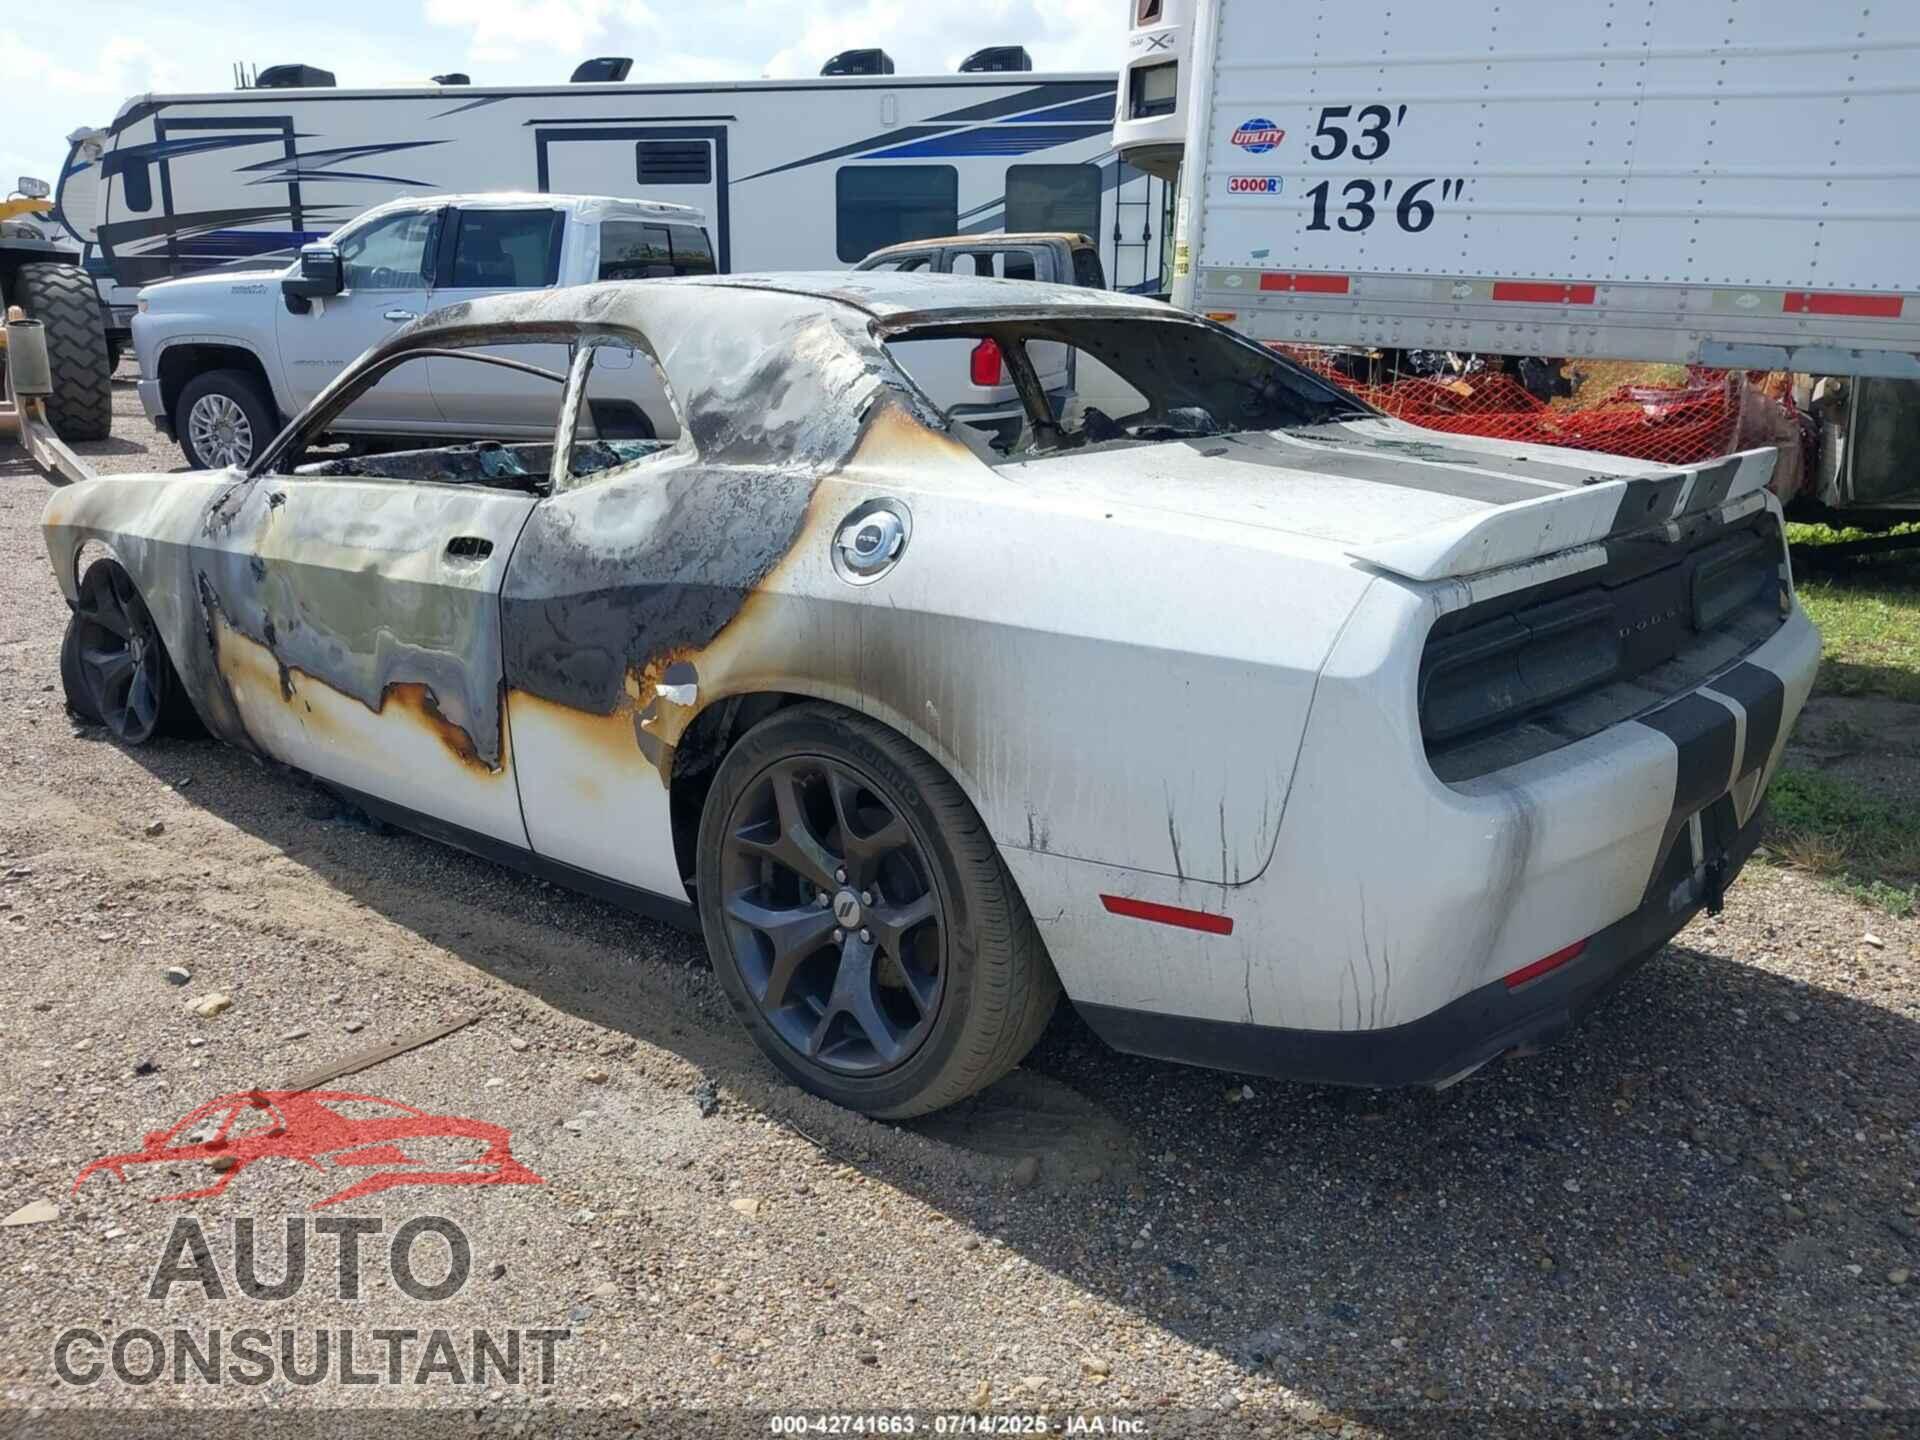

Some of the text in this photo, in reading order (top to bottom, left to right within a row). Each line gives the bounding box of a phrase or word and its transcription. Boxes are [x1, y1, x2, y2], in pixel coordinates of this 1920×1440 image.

[1233, 131, 1282, 144] UTILITY
[1310, 104, 1407, 161] 53'
[1230, 178, 1277, 192] 3000R
[1305, 178, 1465, 233] 13'6"
